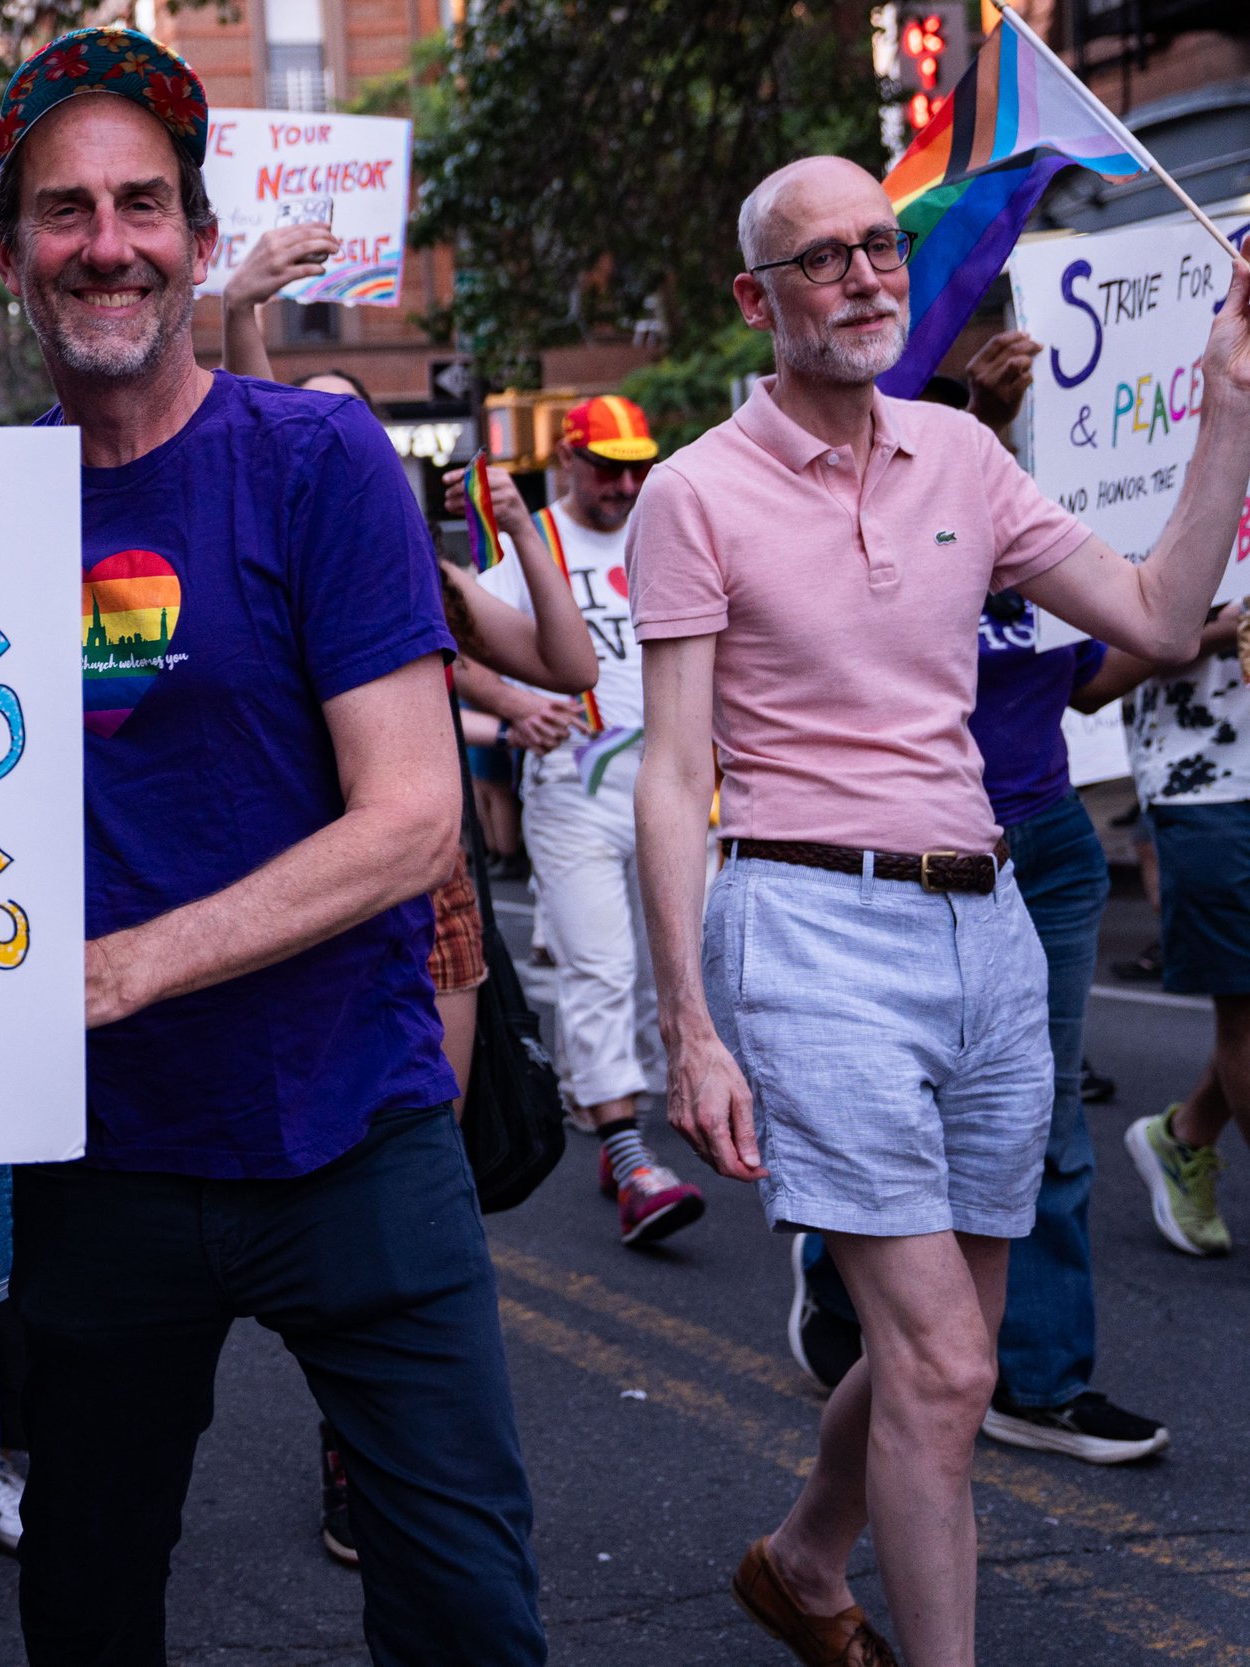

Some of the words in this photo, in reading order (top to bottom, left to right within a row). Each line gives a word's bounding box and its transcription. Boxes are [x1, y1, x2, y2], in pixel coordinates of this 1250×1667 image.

[269, 124, 332, 151] YOUR
[257, 161, 392, 200] NEIGHBOR
[1051, 259, 1163, 389] STRIVE
[1177, 254, 1213, 301] FOR
[1070, 404, 1098, 449] &
[1111, 356, 1203, 449] PEACE
[1096, 474, 1147, 509] HONOR
[1151, 463, 1177, 493] THE
[165, 652, 189, 671] you
